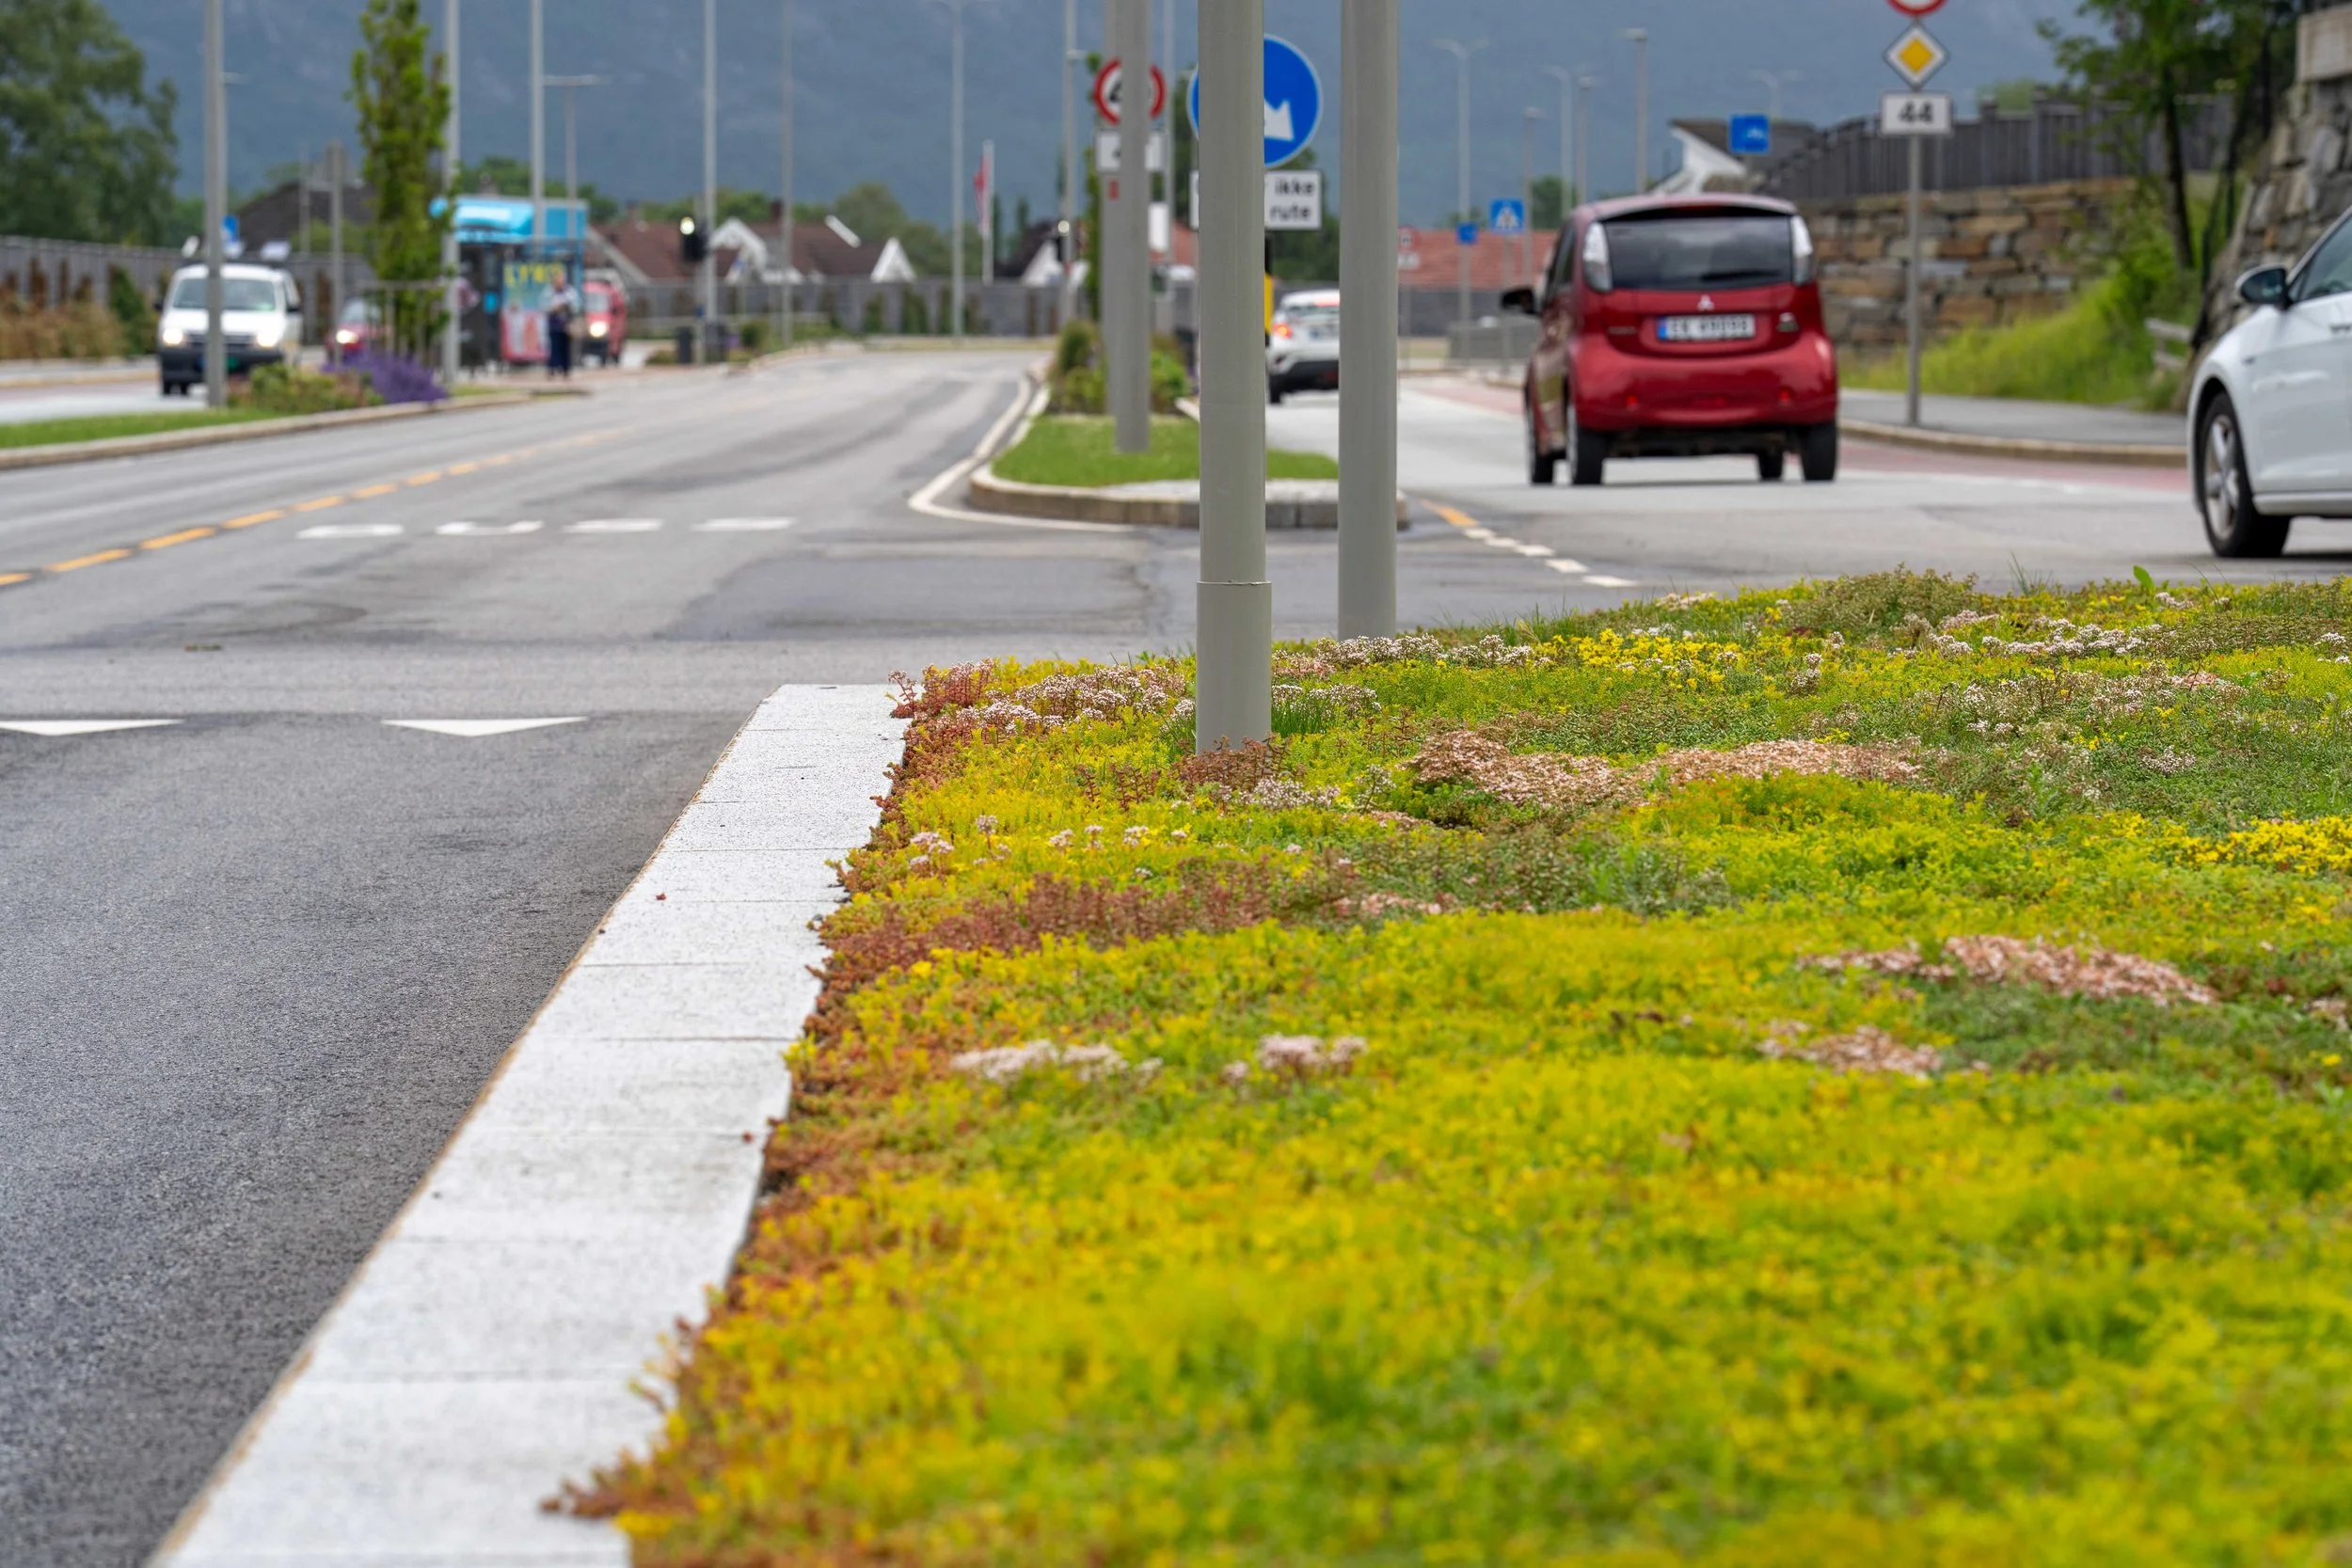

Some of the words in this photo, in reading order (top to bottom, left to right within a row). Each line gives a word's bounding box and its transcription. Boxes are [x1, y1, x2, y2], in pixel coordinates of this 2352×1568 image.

[1899, 101, 1933, 123] 44
[1275, 177, 1314, 196] ikke
[1270, 203, 1311, 221] rute
